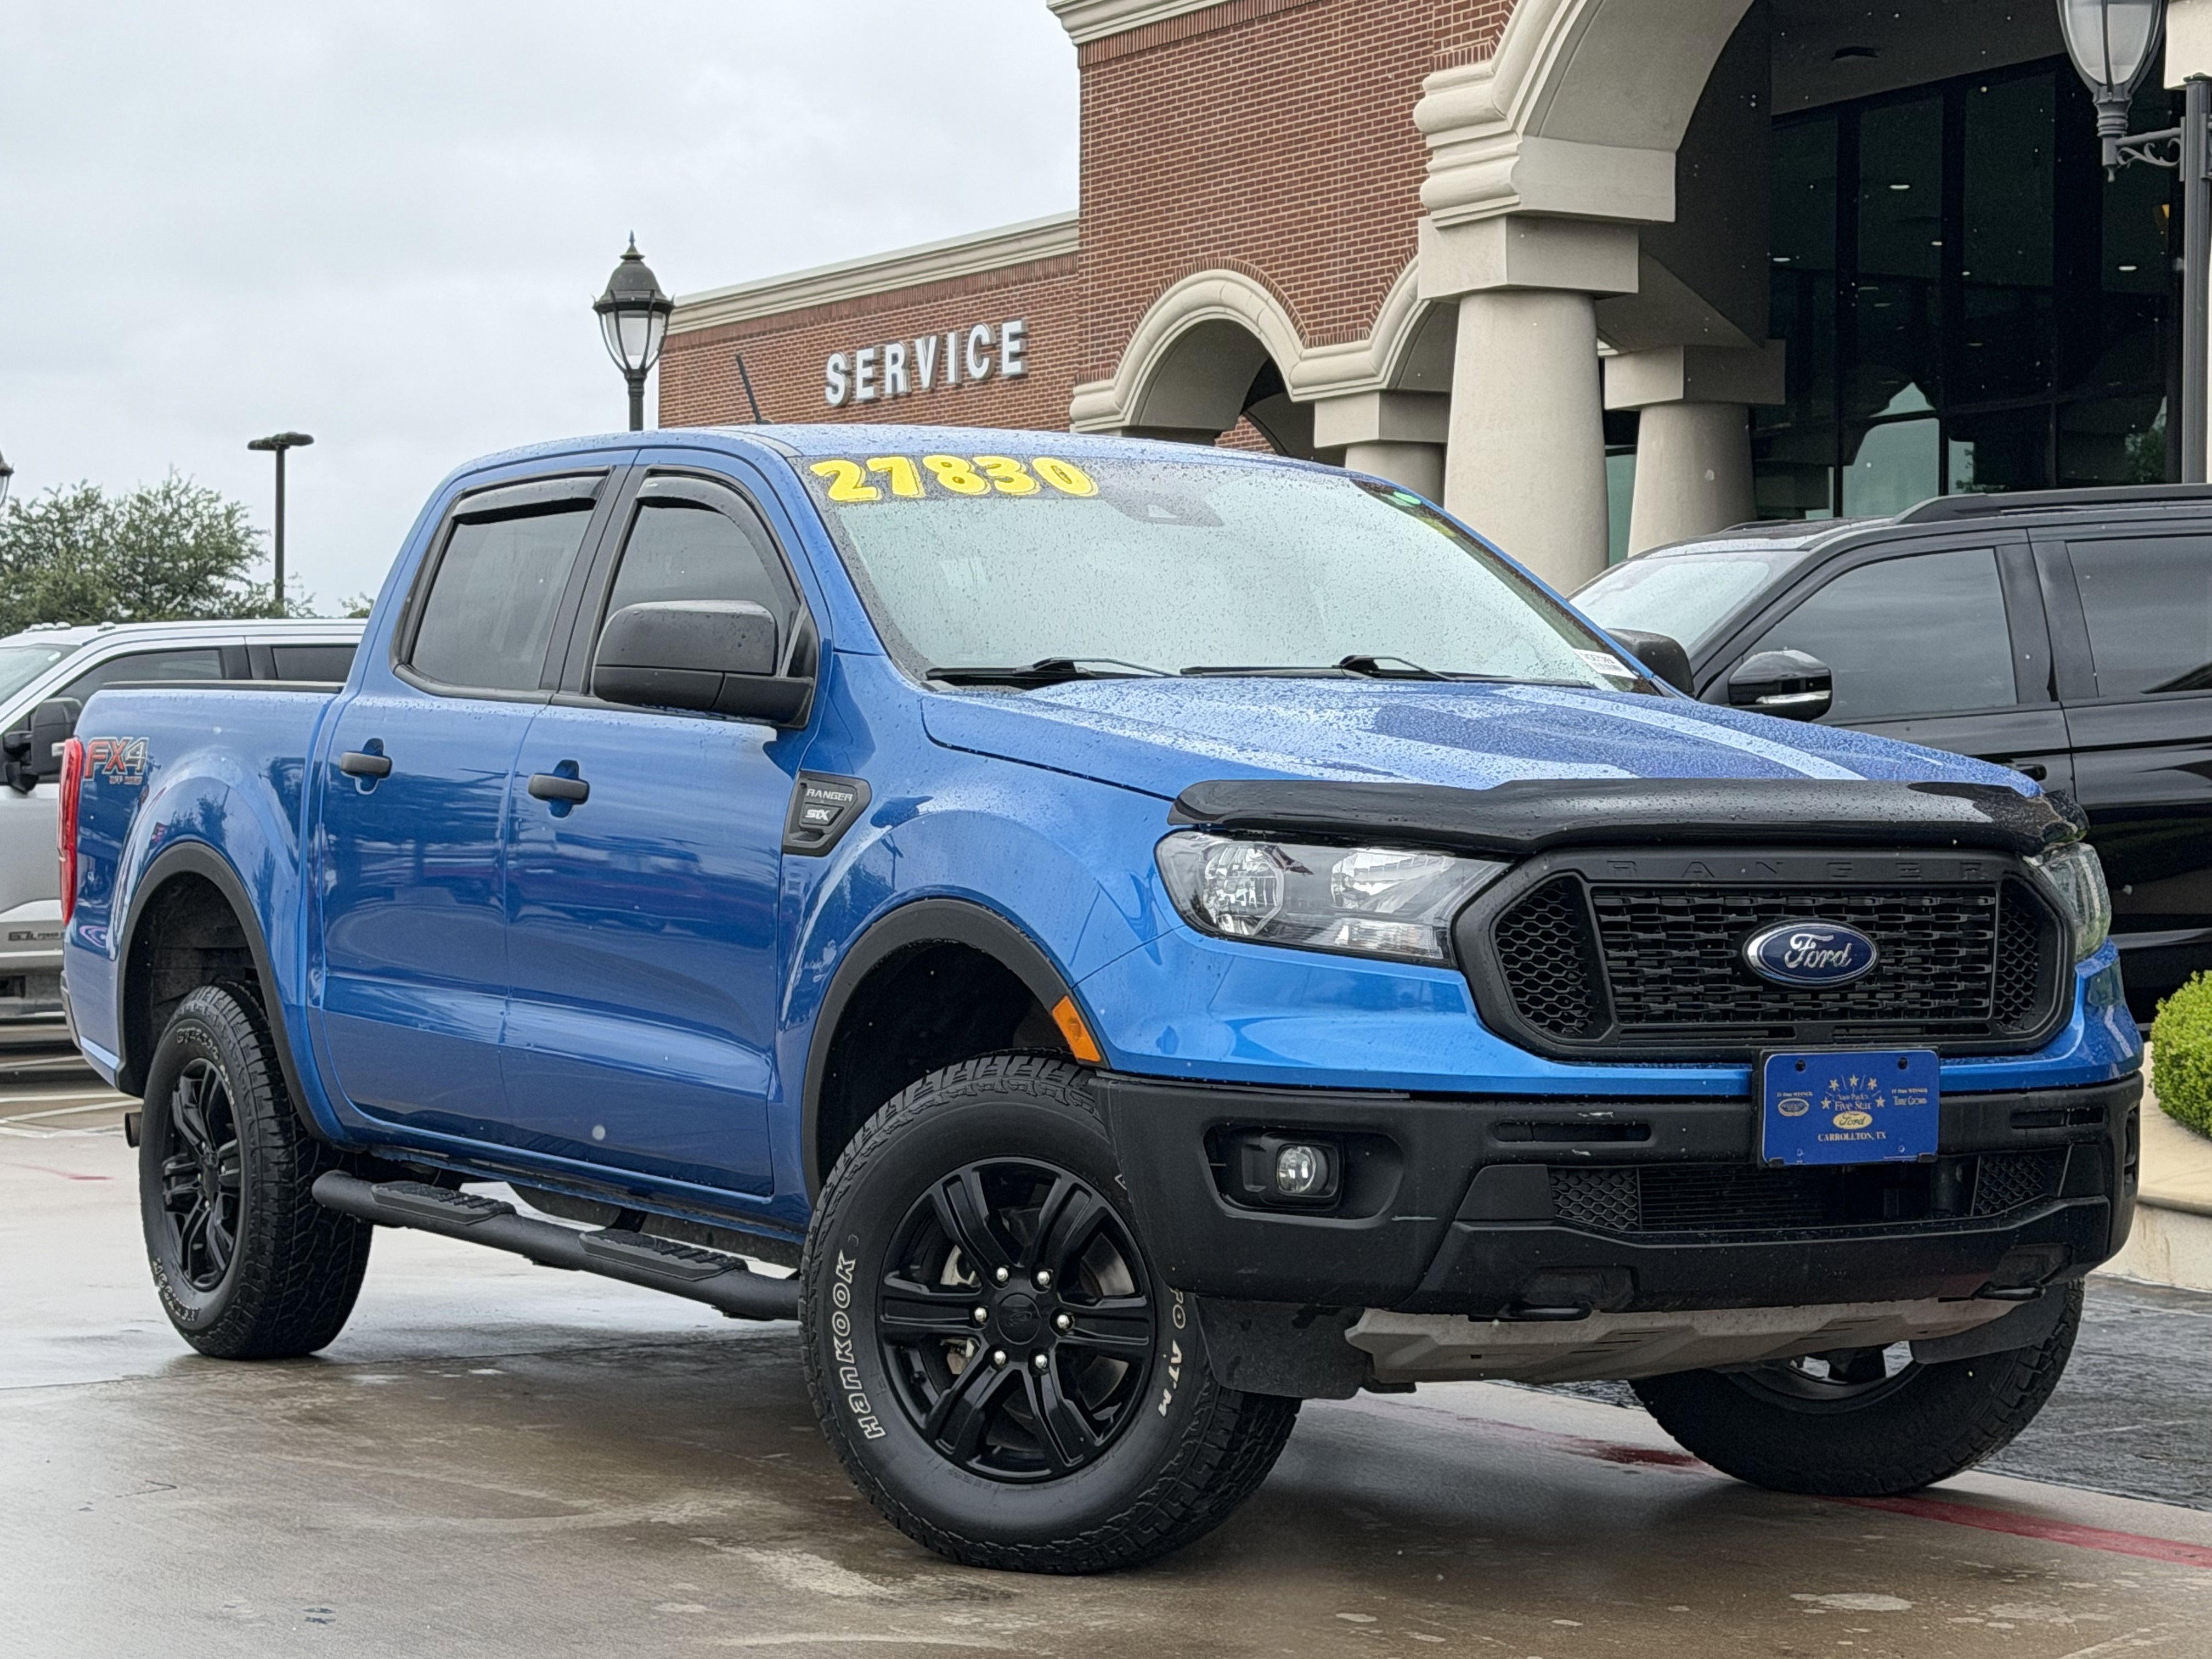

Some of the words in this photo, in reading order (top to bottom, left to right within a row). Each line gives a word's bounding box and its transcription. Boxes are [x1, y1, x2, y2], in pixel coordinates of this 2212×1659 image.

[825, 318, 1027, 407] SERVICE
[810, 455, 1098, 501] 27830
[82, 736, 149, 781] FX4
[806, 788, 854, 802] RANGER
[805, 809, 831, 821] STX
[1784, 933, 1853, 969] Ford
[1835, 1101, 1853, 1111] Five
[1855, 1100, 1871, 1110] Star
[1839, 1113, 1866, 1126] Ford
[1817, 1132, 1874, 1142] CARROLLTON,
[1876, 1131, 1887, 1140] TX
